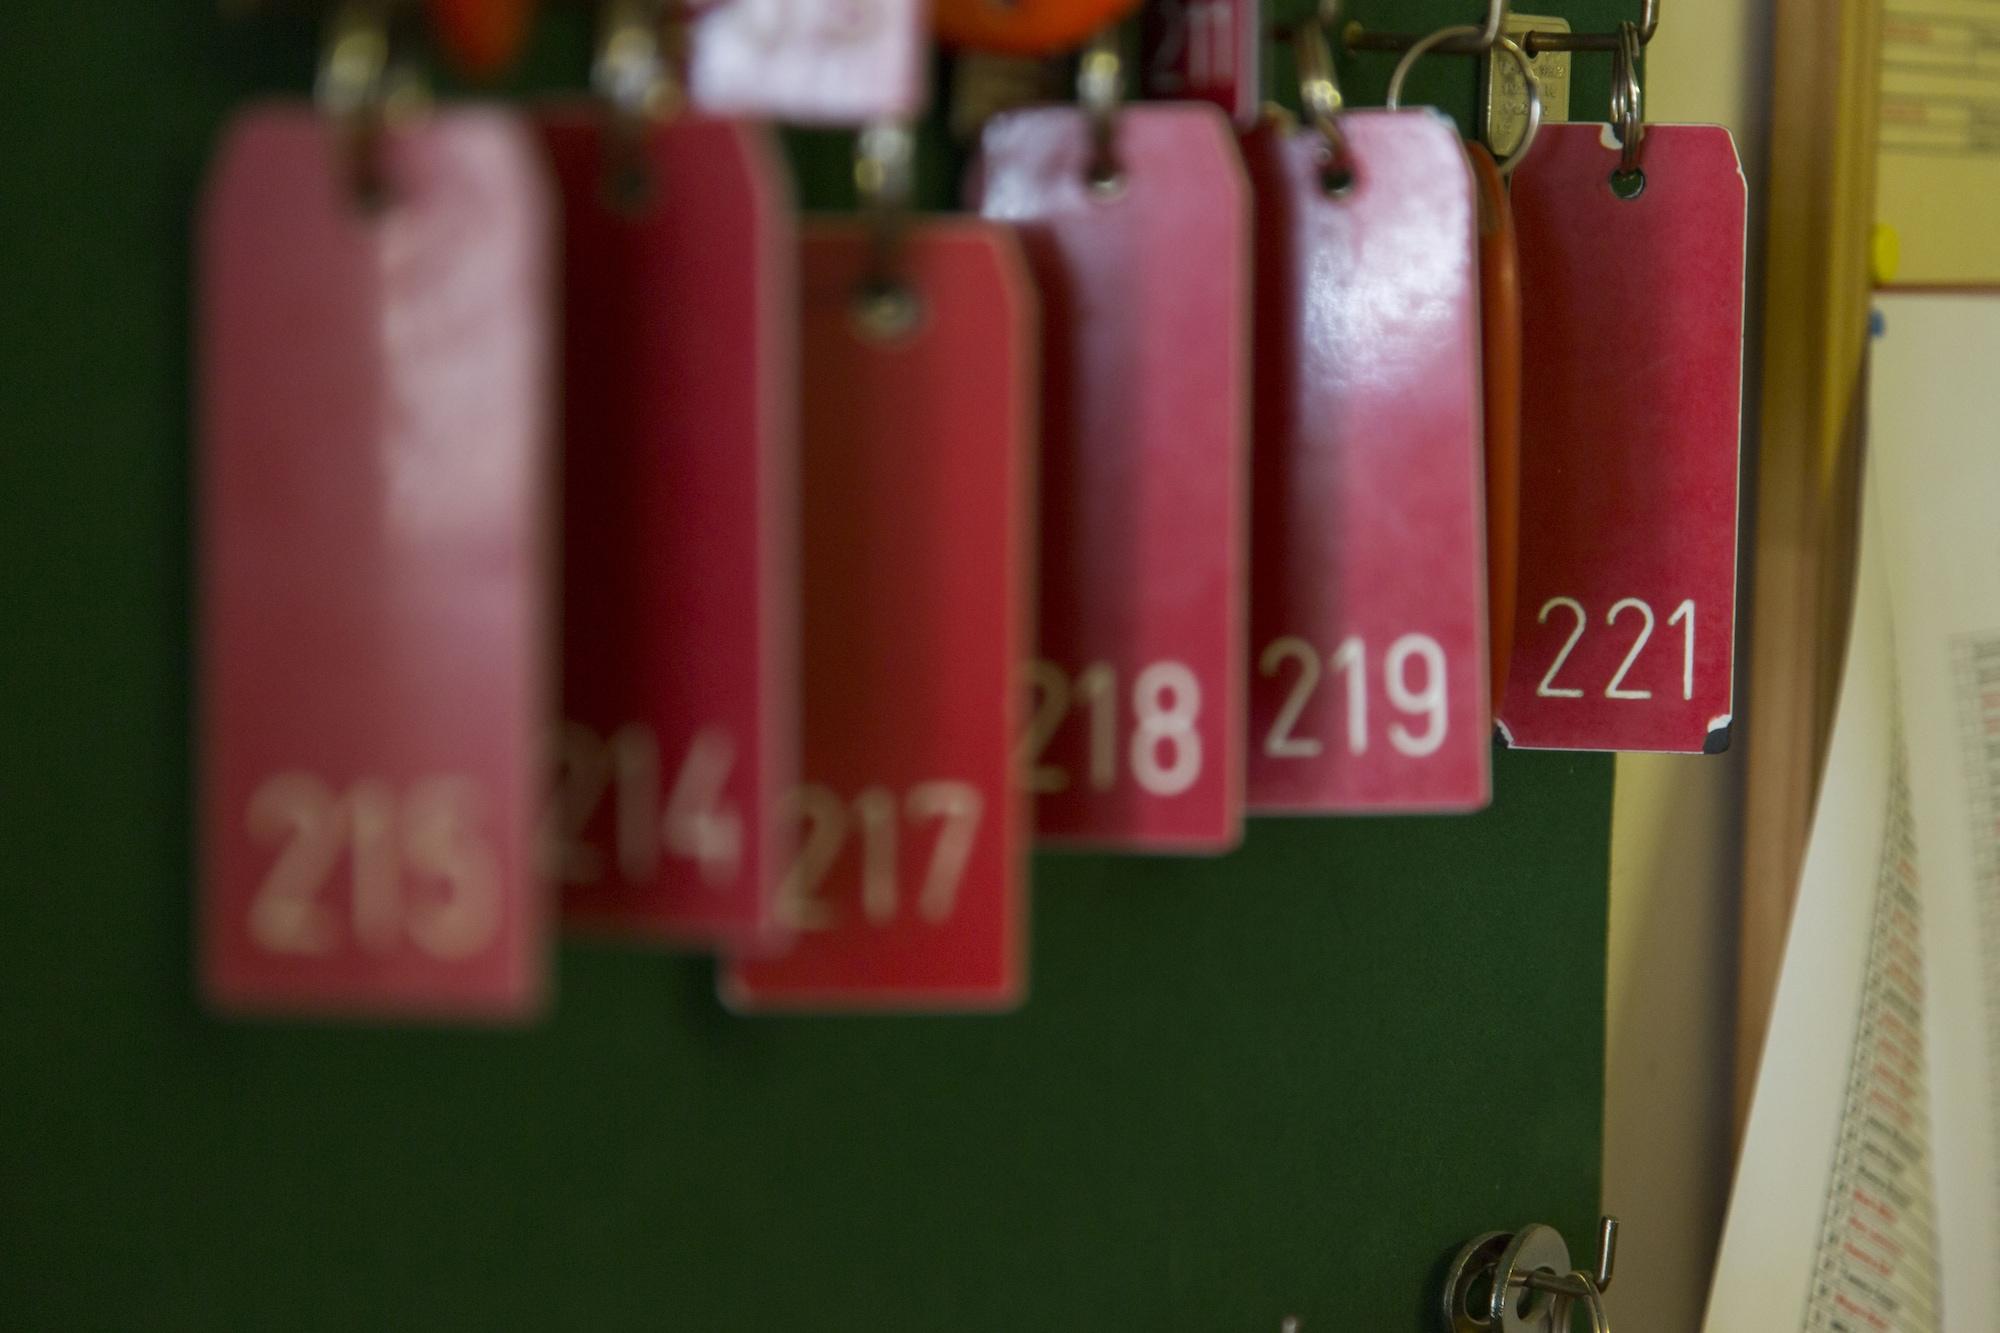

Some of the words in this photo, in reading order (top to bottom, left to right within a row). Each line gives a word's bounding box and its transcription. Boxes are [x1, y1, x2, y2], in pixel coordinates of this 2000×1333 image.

[1260, 634, 1448, 758] 219
[1538, 597, 1695, 700] 221
[1016, 661, 1202, 797] 218
[248, 775, 499, 958] 215
[774, 780, 984, 926] 217
